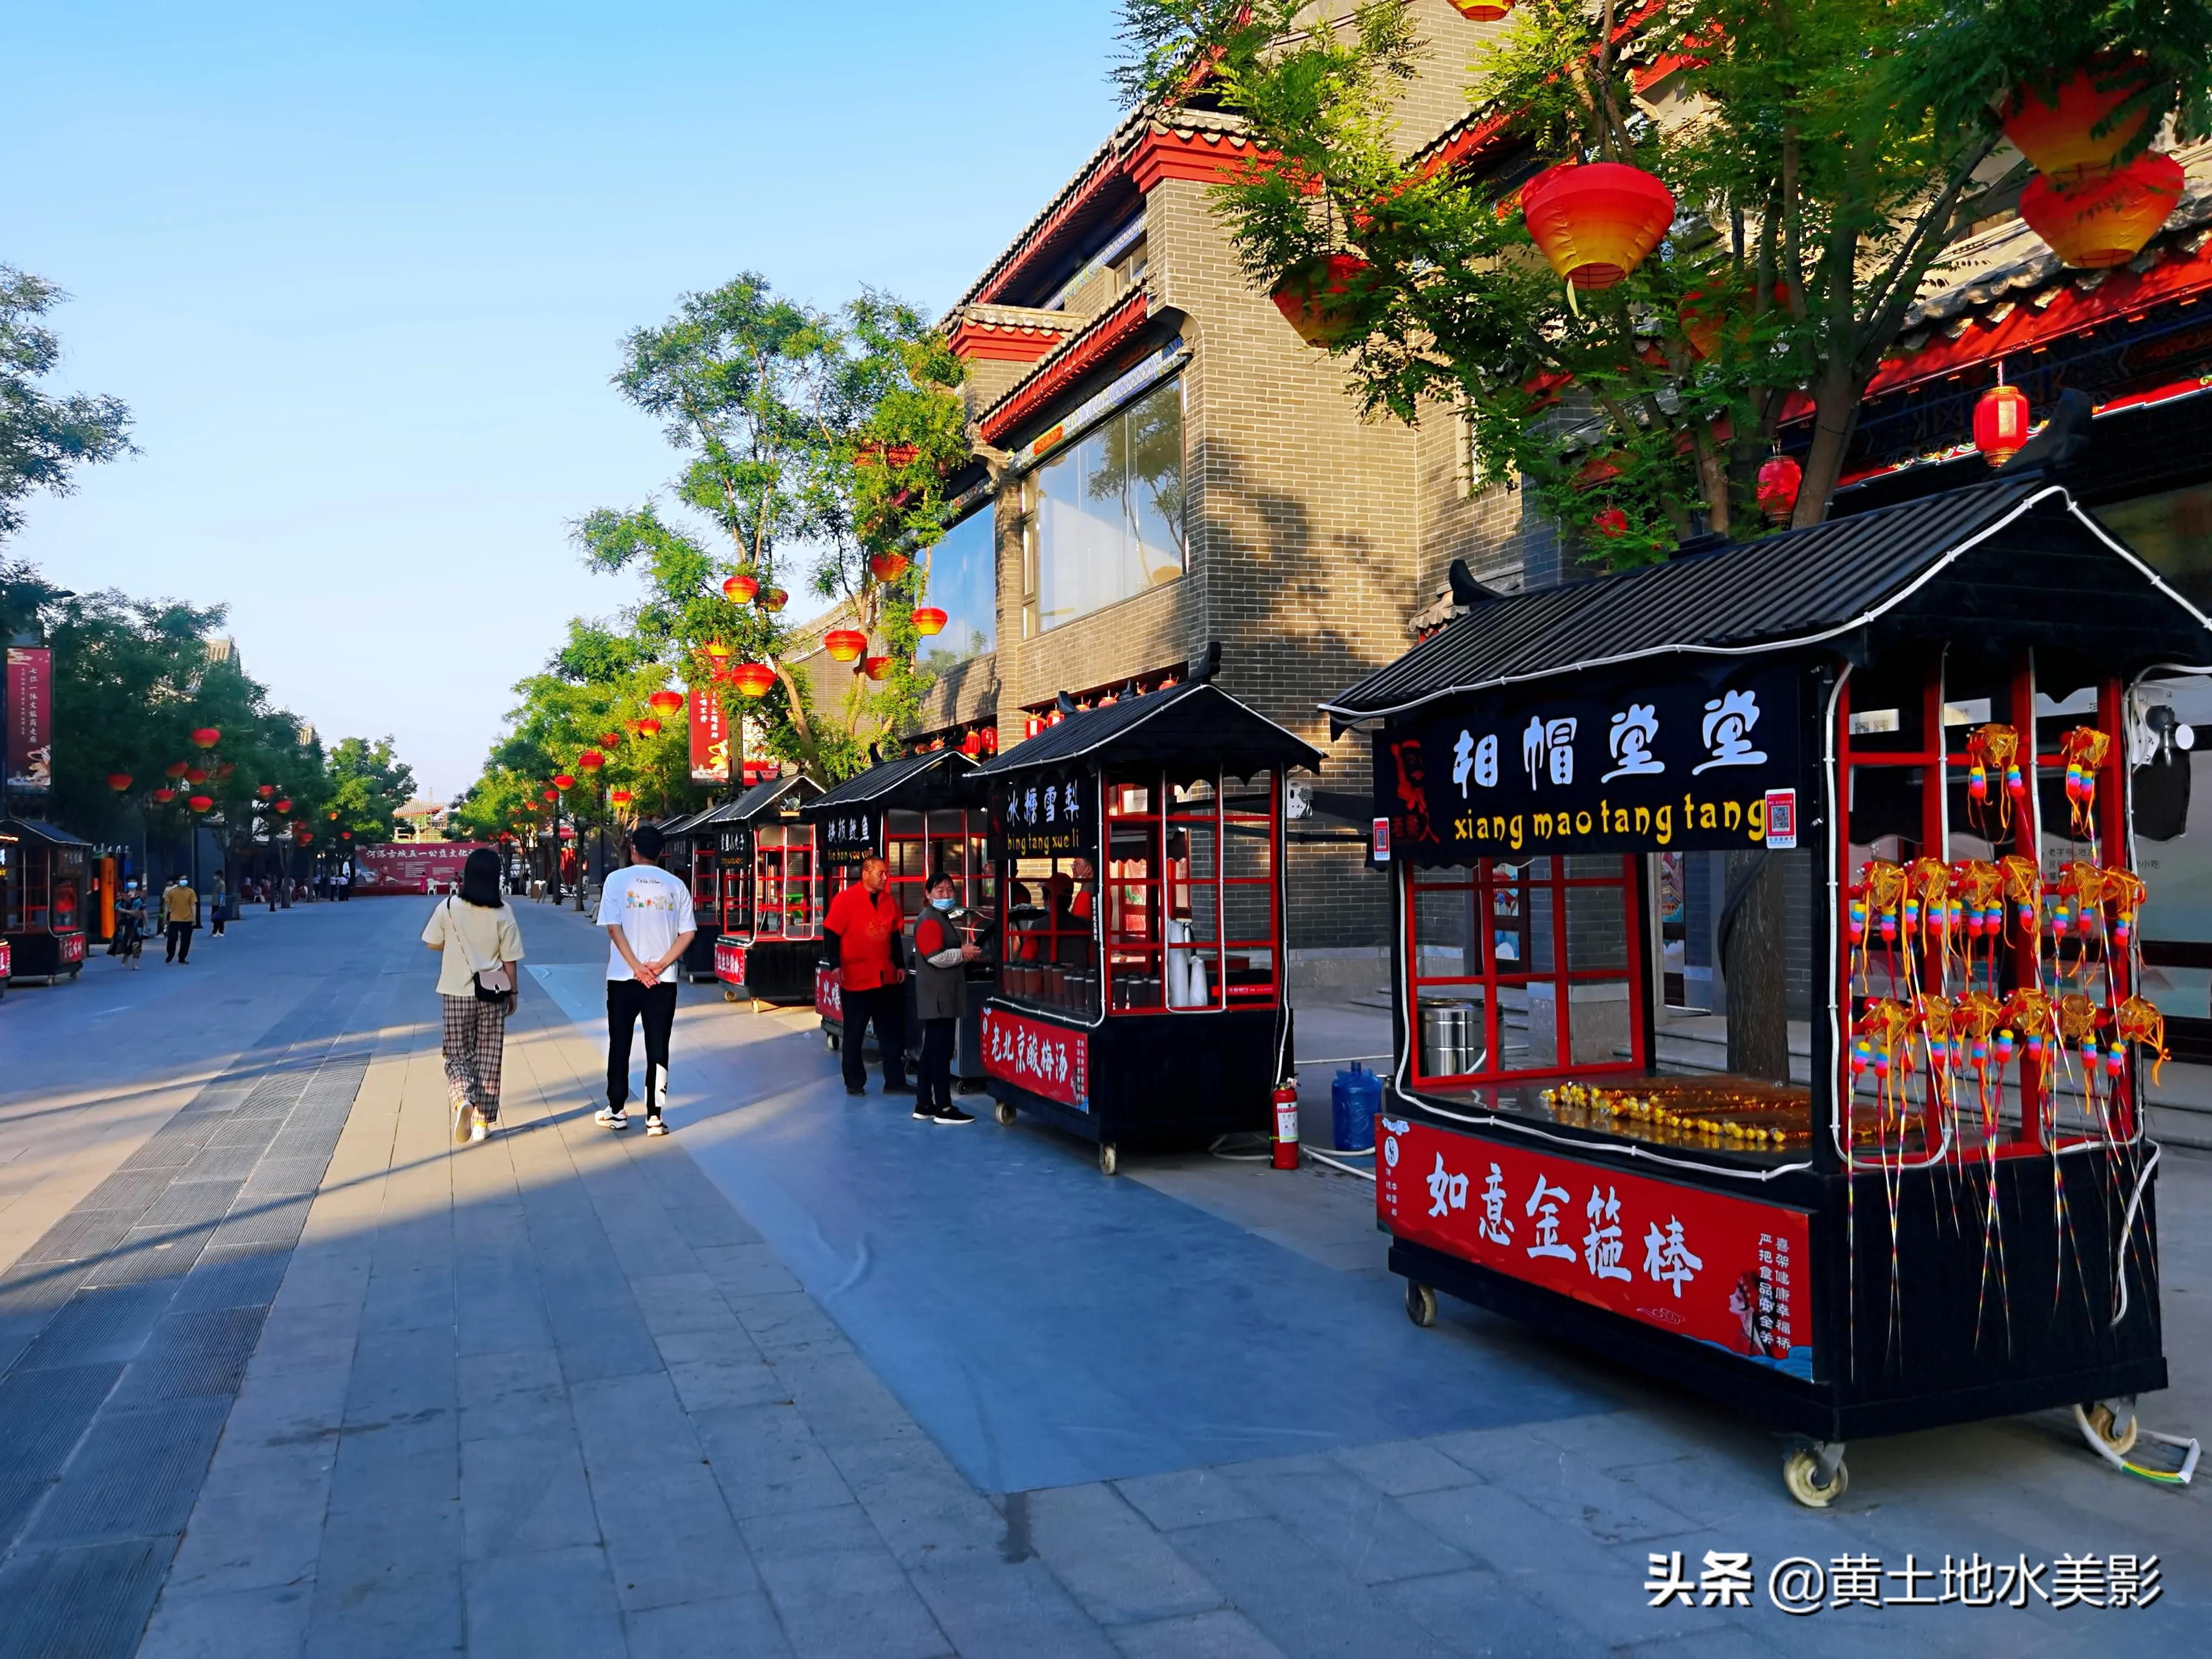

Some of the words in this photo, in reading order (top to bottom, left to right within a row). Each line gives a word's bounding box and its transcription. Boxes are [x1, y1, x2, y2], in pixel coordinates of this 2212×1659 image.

[1007, 778, 1080, 827] 冰糖雪梨
[1454, 809, 1523, 849] xiang
[1533, 810, 1592, 840] mao
[1601, 799, 1673, 844] tang
[1684, 793, 1766, 841] tang
[849, 851, 860, 864] you
[1008, 833, 1026, 856] bing
[1028, 833, 1049, 855] tang
[1053, 835, 1070, 848] xue
[1073, 828, 1080, 847] li
[991, 1021, 1069, 1084] 老北京酸梅汤
[1427, 1151, 1703, 1298] 如意金箍棒
